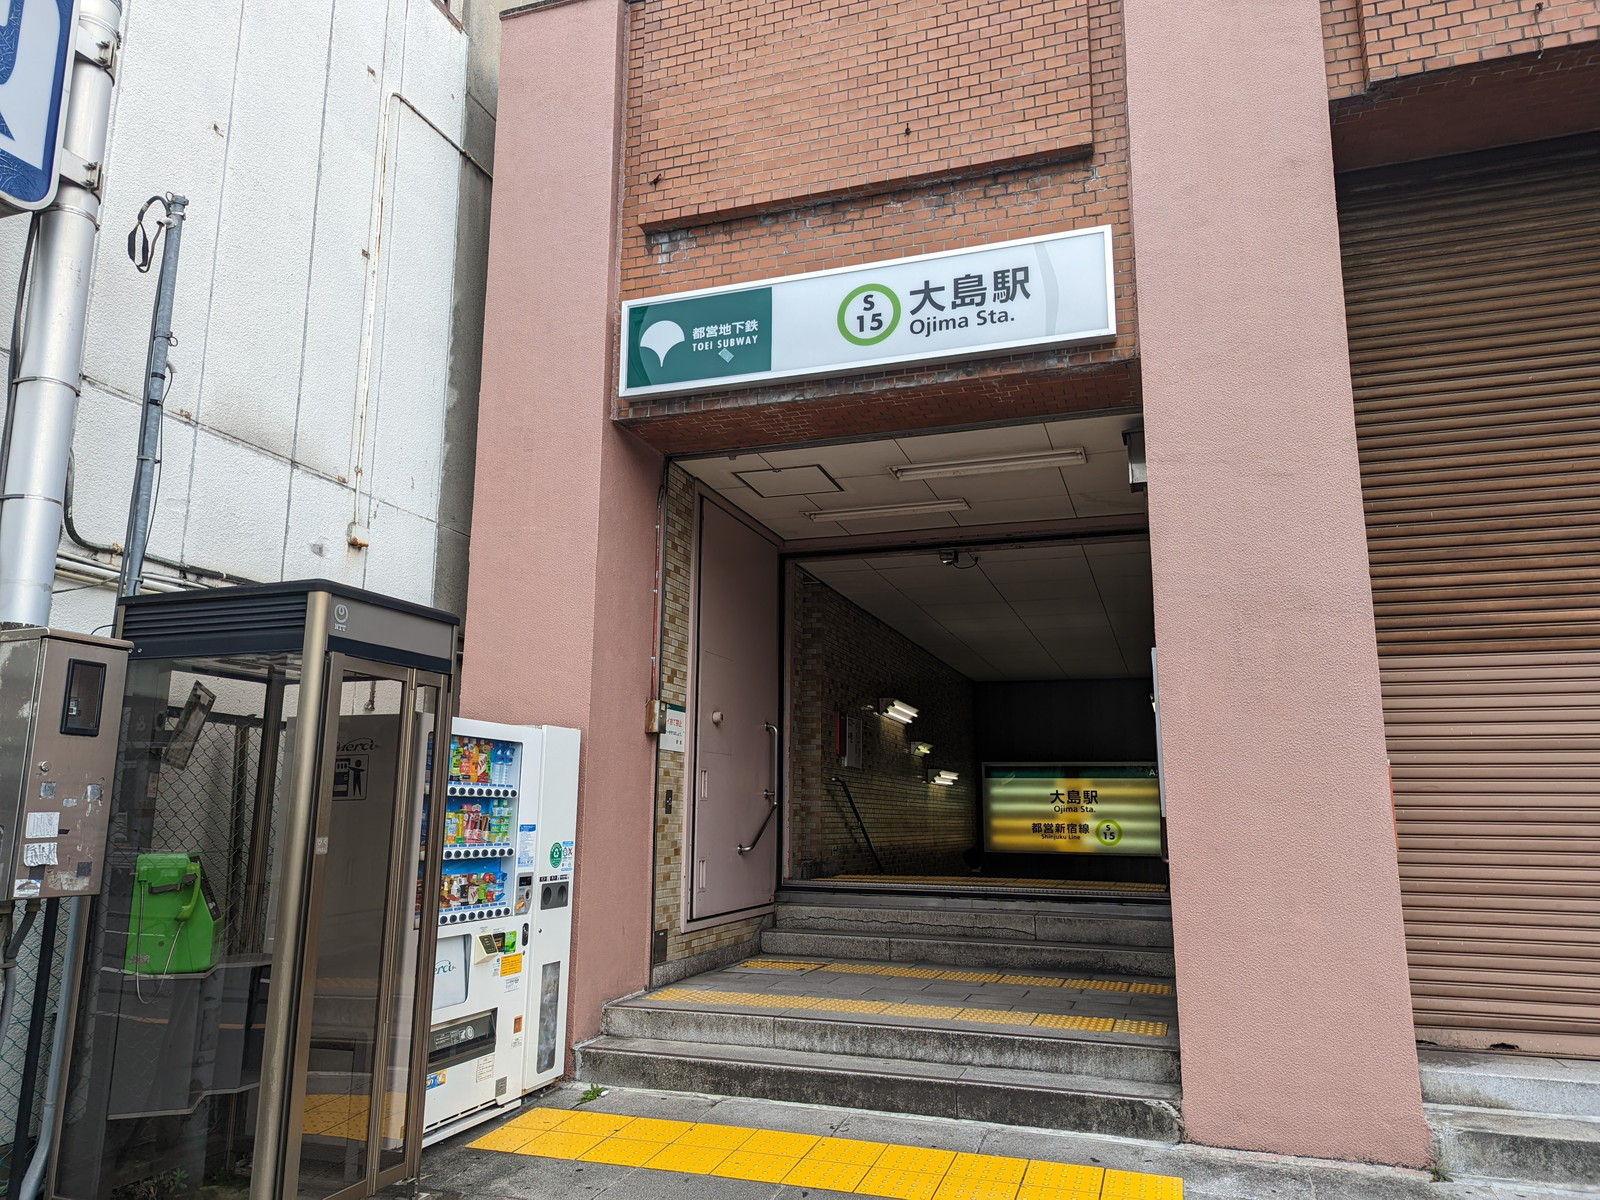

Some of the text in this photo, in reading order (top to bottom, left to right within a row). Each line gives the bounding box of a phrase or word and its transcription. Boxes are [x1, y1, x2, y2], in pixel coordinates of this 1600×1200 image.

[909, 266, 1031, 316] 大島駅
[863, 294, 875, 312] S
[692, 319, 758, 340] 都営地下鉄
[856, 312, 883, 333] 15
[909, 309, 1015, 338] Ojima Sta.
[692, 335, 758, 352] TOEI SUBWAY
[1049, 789, 1098, 805] 大島駅
[1053, 805, 1096, 814] Ojima Sta.
[1031, 822, 1090, 834] 都営新宿線
[1103, 832, 1115, 840] 15
